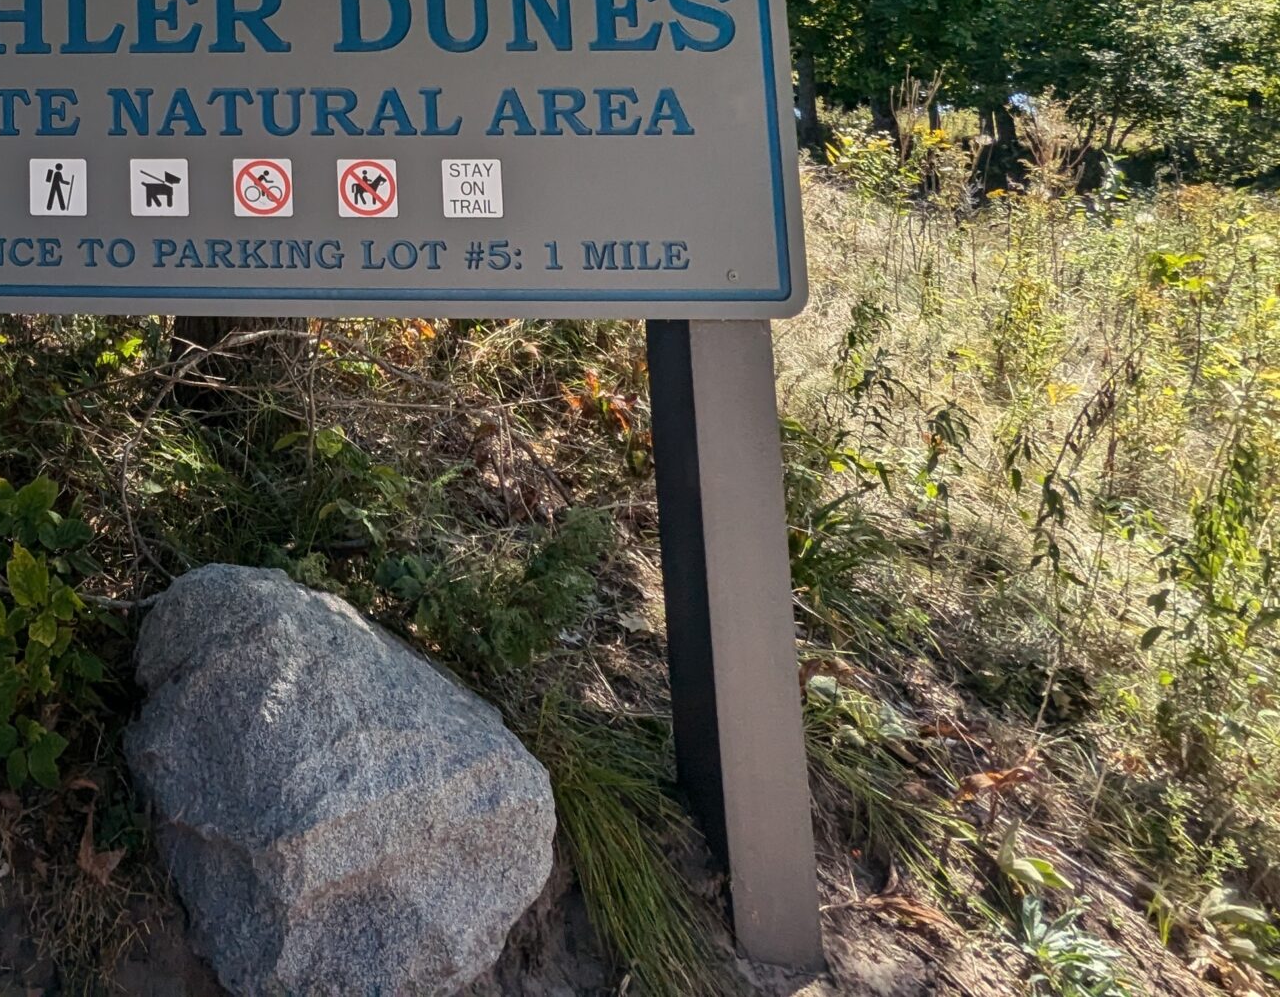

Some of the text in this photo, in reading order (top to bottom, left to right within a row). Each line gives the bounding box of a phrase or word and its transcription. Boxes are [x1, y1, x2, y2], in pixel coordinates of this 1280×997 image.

[107, 87, 463, 137] NATURAL
[485, 86, 696, 136] AREA
[449, 163, 494, 178] STAY
[460, 180, 486, 196] ON
[450, 199, 497, 214] TRAIL
[76, 238, 137, 269] TO
[152, 238, 346, 270] PARKING
[360, 239, 448, 270] LOT
[463, 239, 523, 270] #5:
[545, 241, 563, 270] 1
[582, 241, 690, 270] MILE
